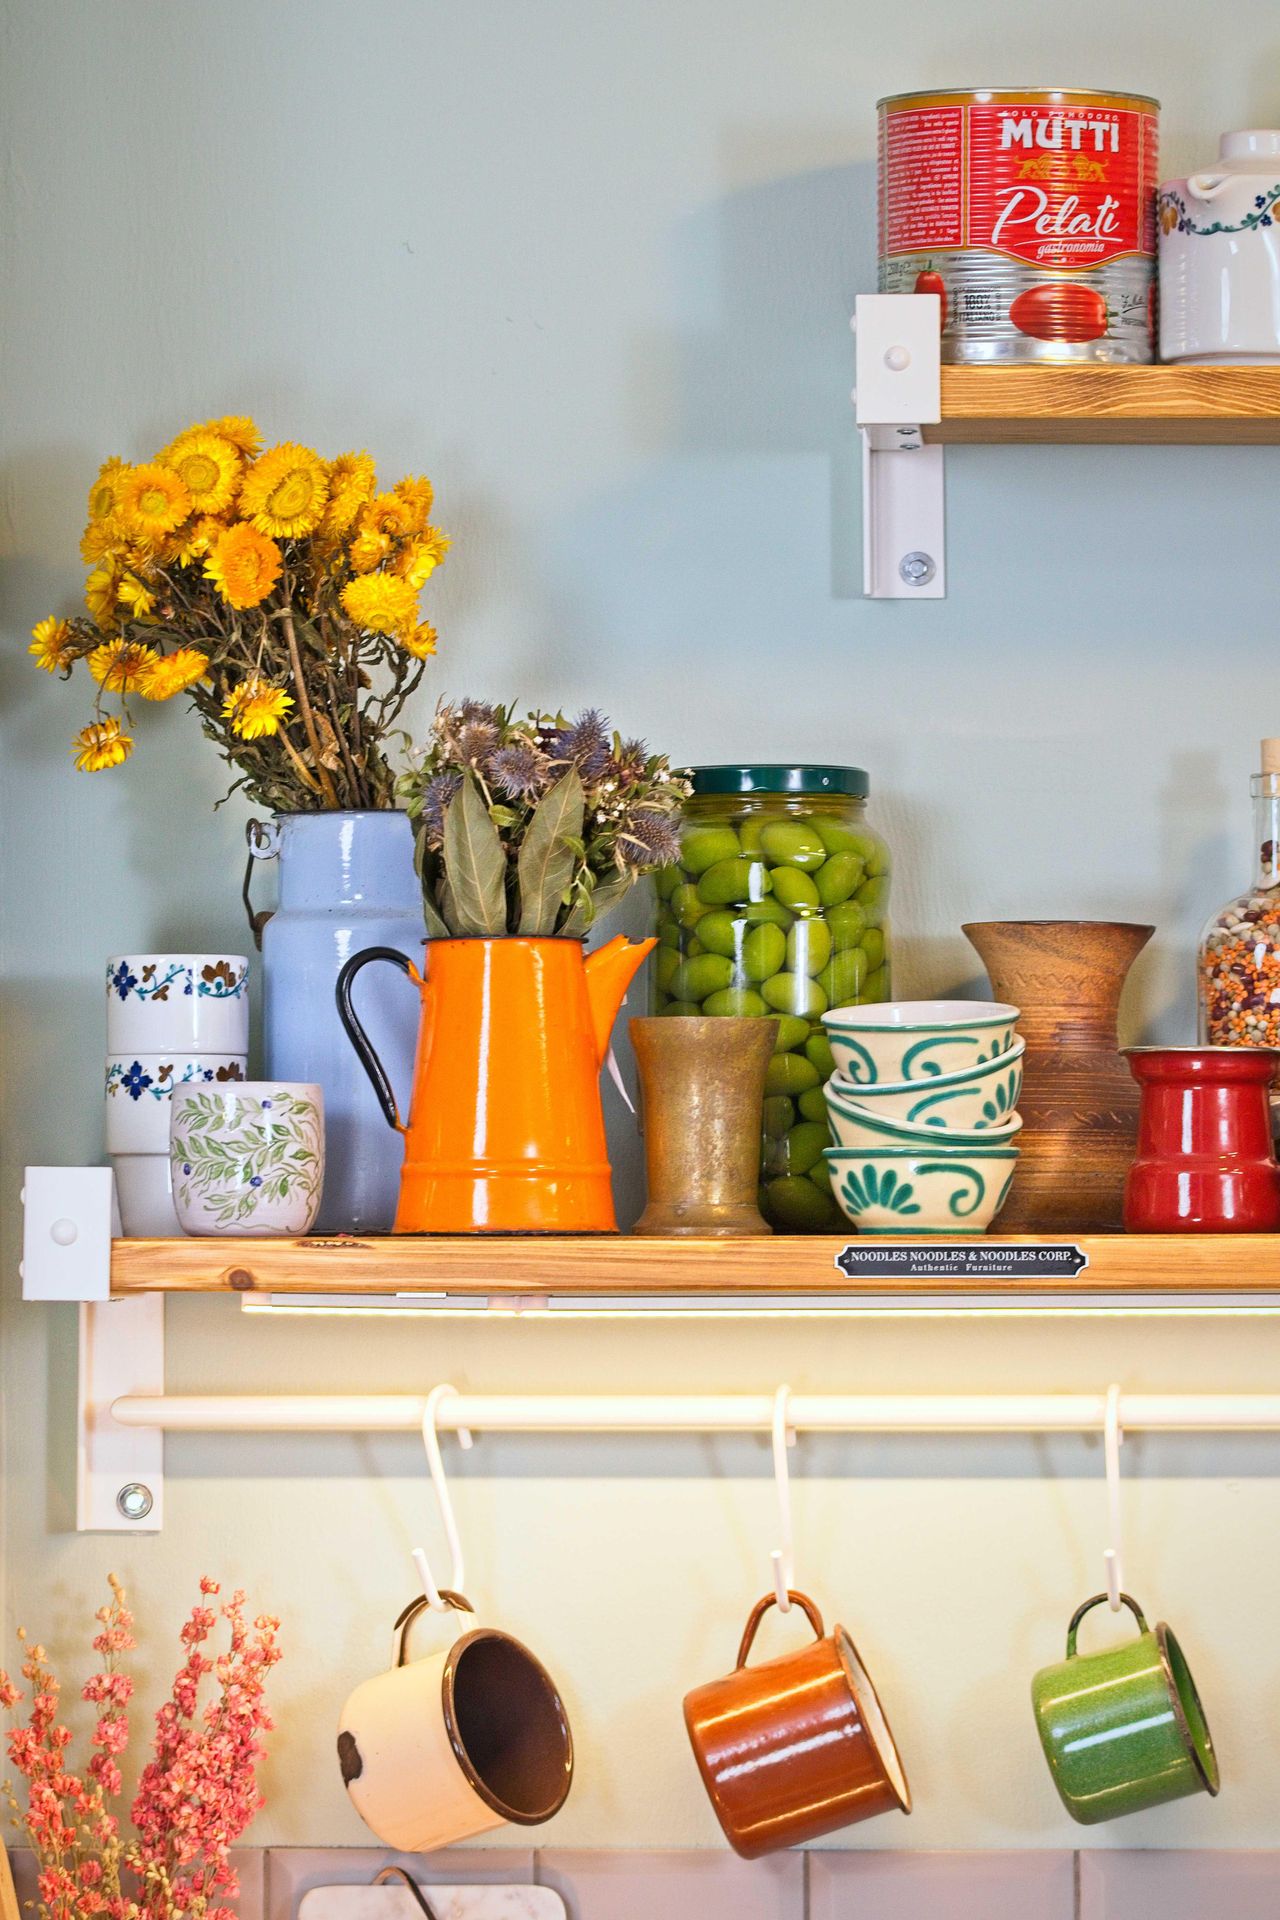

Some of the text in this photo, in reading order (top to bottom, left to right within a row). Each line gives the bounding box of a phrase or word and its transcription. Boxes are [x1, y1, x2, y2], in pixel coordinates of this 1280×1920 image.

[1001, 118, 1120, 153] MUTTI
[991, 185, 1121, 244] Pelati
[1036, 240, 1105, 259] gastronomia
[850, 1251, 1073, 1262] NOODLES NOODLES & NOODLES CORP.
[910, 1263, 1013, 1272] Authentic Furniture
